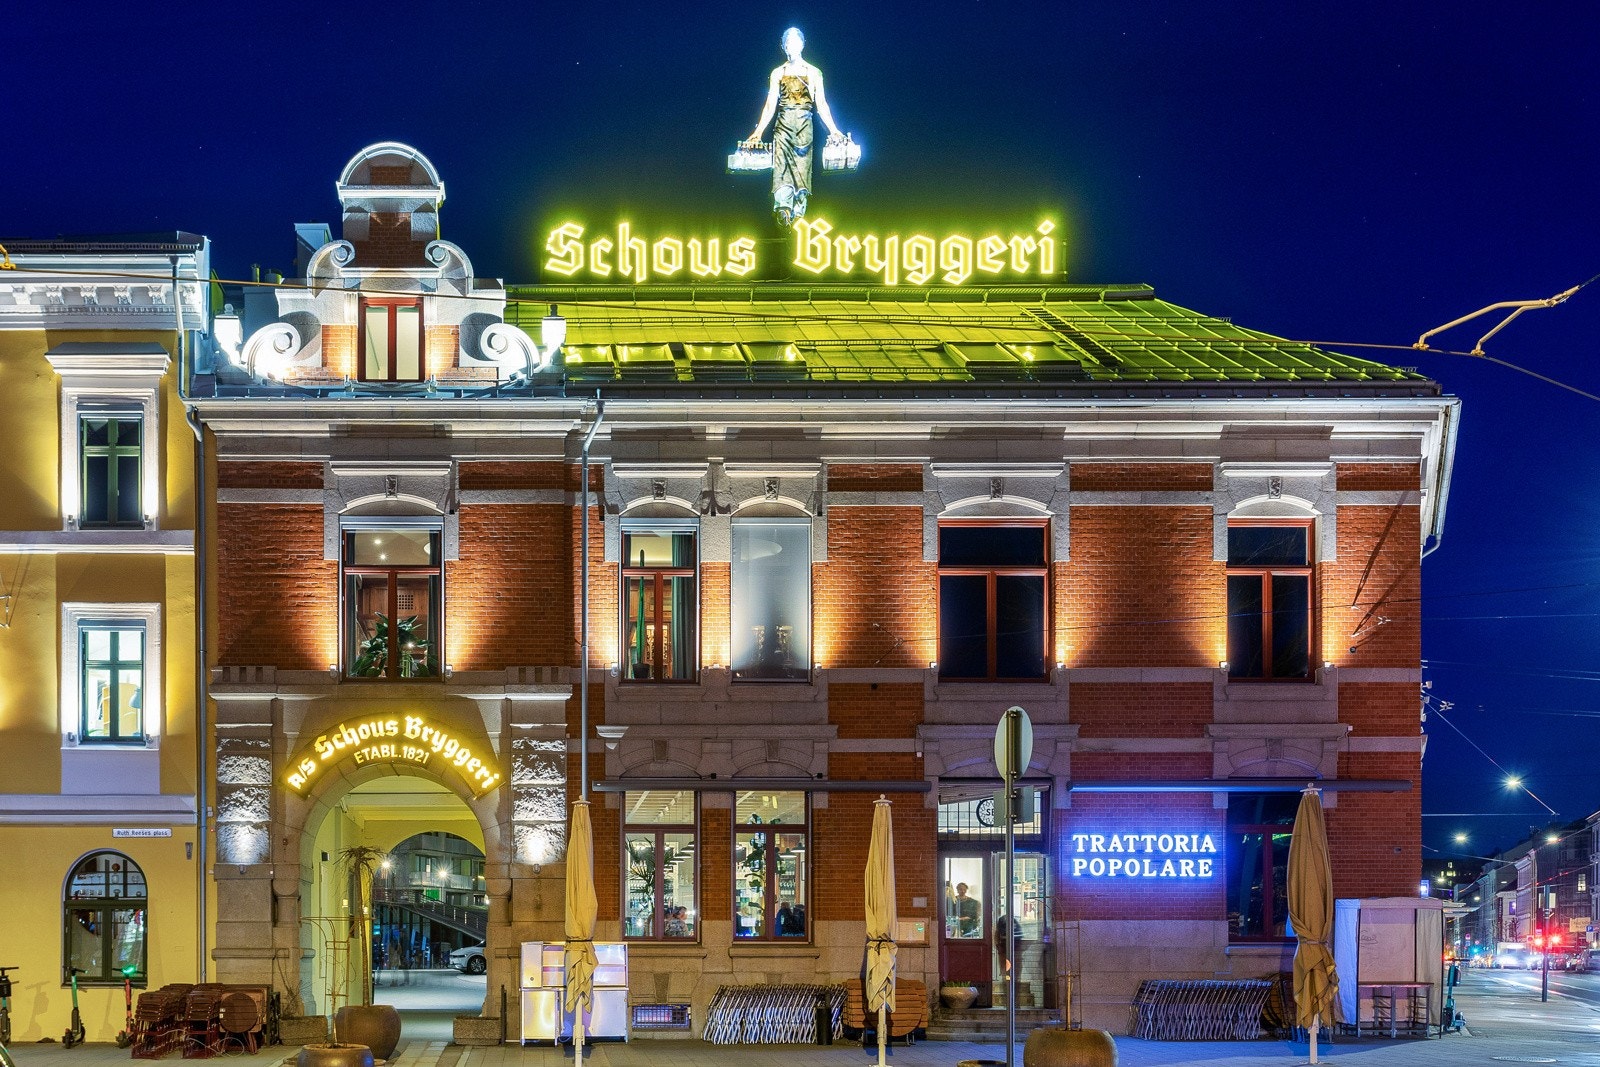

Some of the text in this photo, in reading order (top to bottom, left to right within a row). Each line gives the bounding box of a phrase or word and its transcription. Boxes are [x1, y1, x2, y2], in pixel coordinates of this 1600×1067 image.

[543, 217, 1056, 285] Schous Bryggeri
[314, 719, 399, 760] Schous
[404, 715, 500, 789] Bryggeri
[1072, 834, 1217, 853] TRATTORIA
[1072, 858, 1213, 877] POPOLARE
